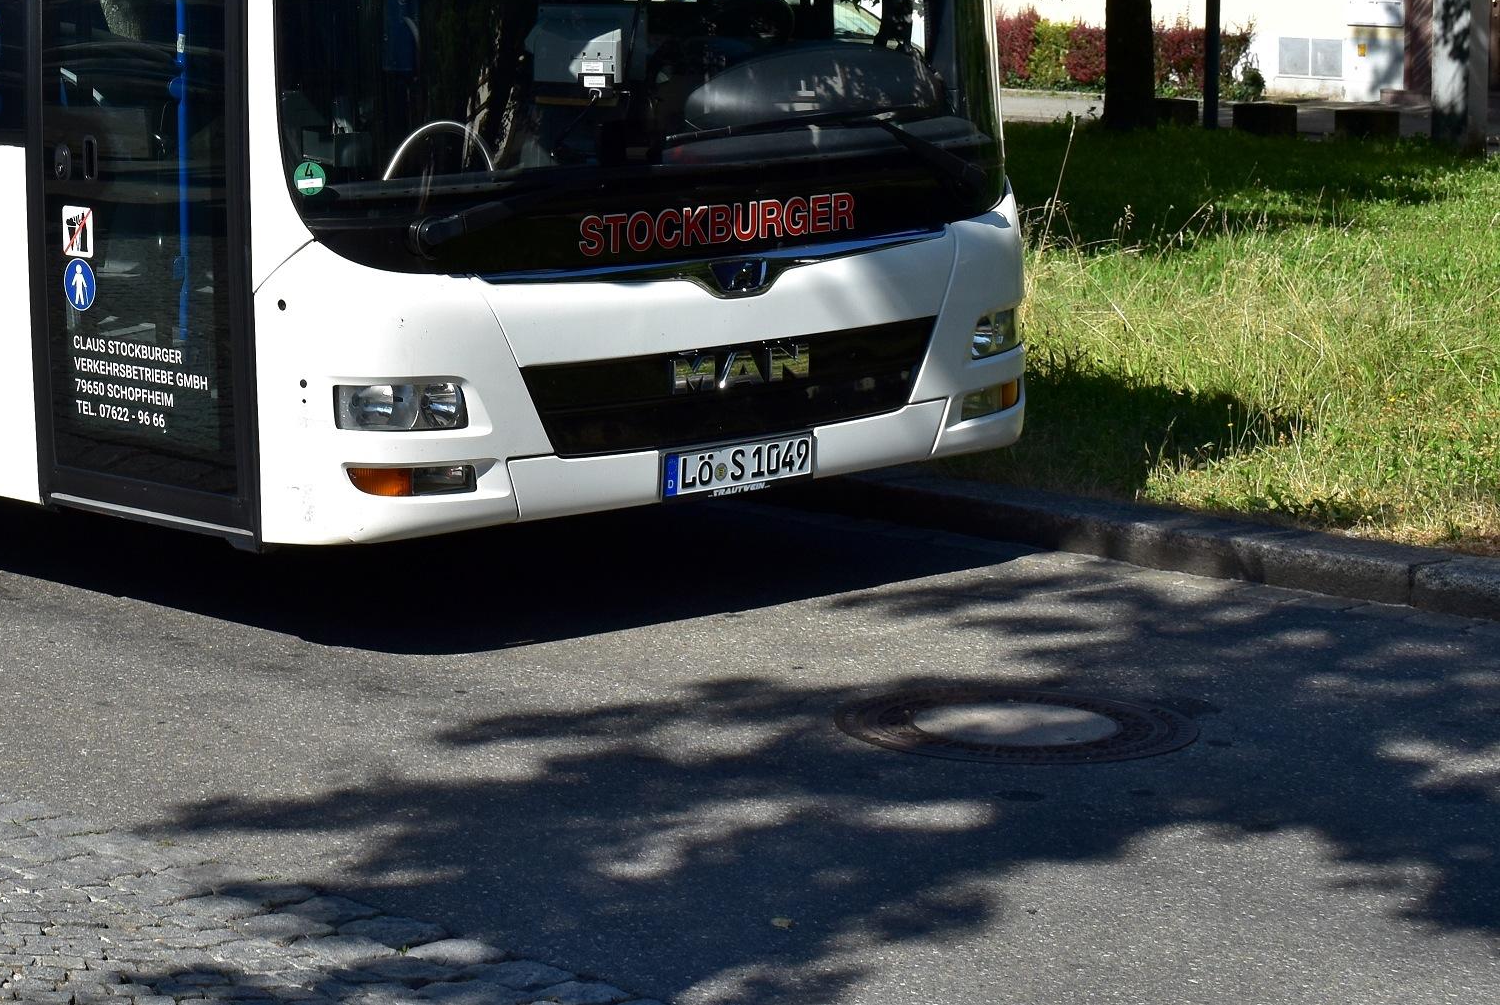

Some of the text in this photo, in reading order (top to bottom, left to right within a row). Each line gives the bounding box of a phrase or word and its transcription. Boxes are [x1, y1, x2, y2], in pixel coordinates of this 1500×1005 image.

[578, 192, 856, 257] STOCKBURGER
[73, 335, 182, 365] CLAUS STOCKBURGER
[73, 356, 209, 391] VERKEHRSBETRIEBE GMBH
[668, 343, 810, 395] MAN
[74, 378, 174, 408] 79650 SCHOPFHEIM
[76, 399, 97, 417] TEL.
[99, 403, 130, 422] 07622
[138, 410, 151, 426] 96
[152, 413, 166, 428] 66
[667, 479, 674, 489] D
[681, 454, 714, 489] LÖ
